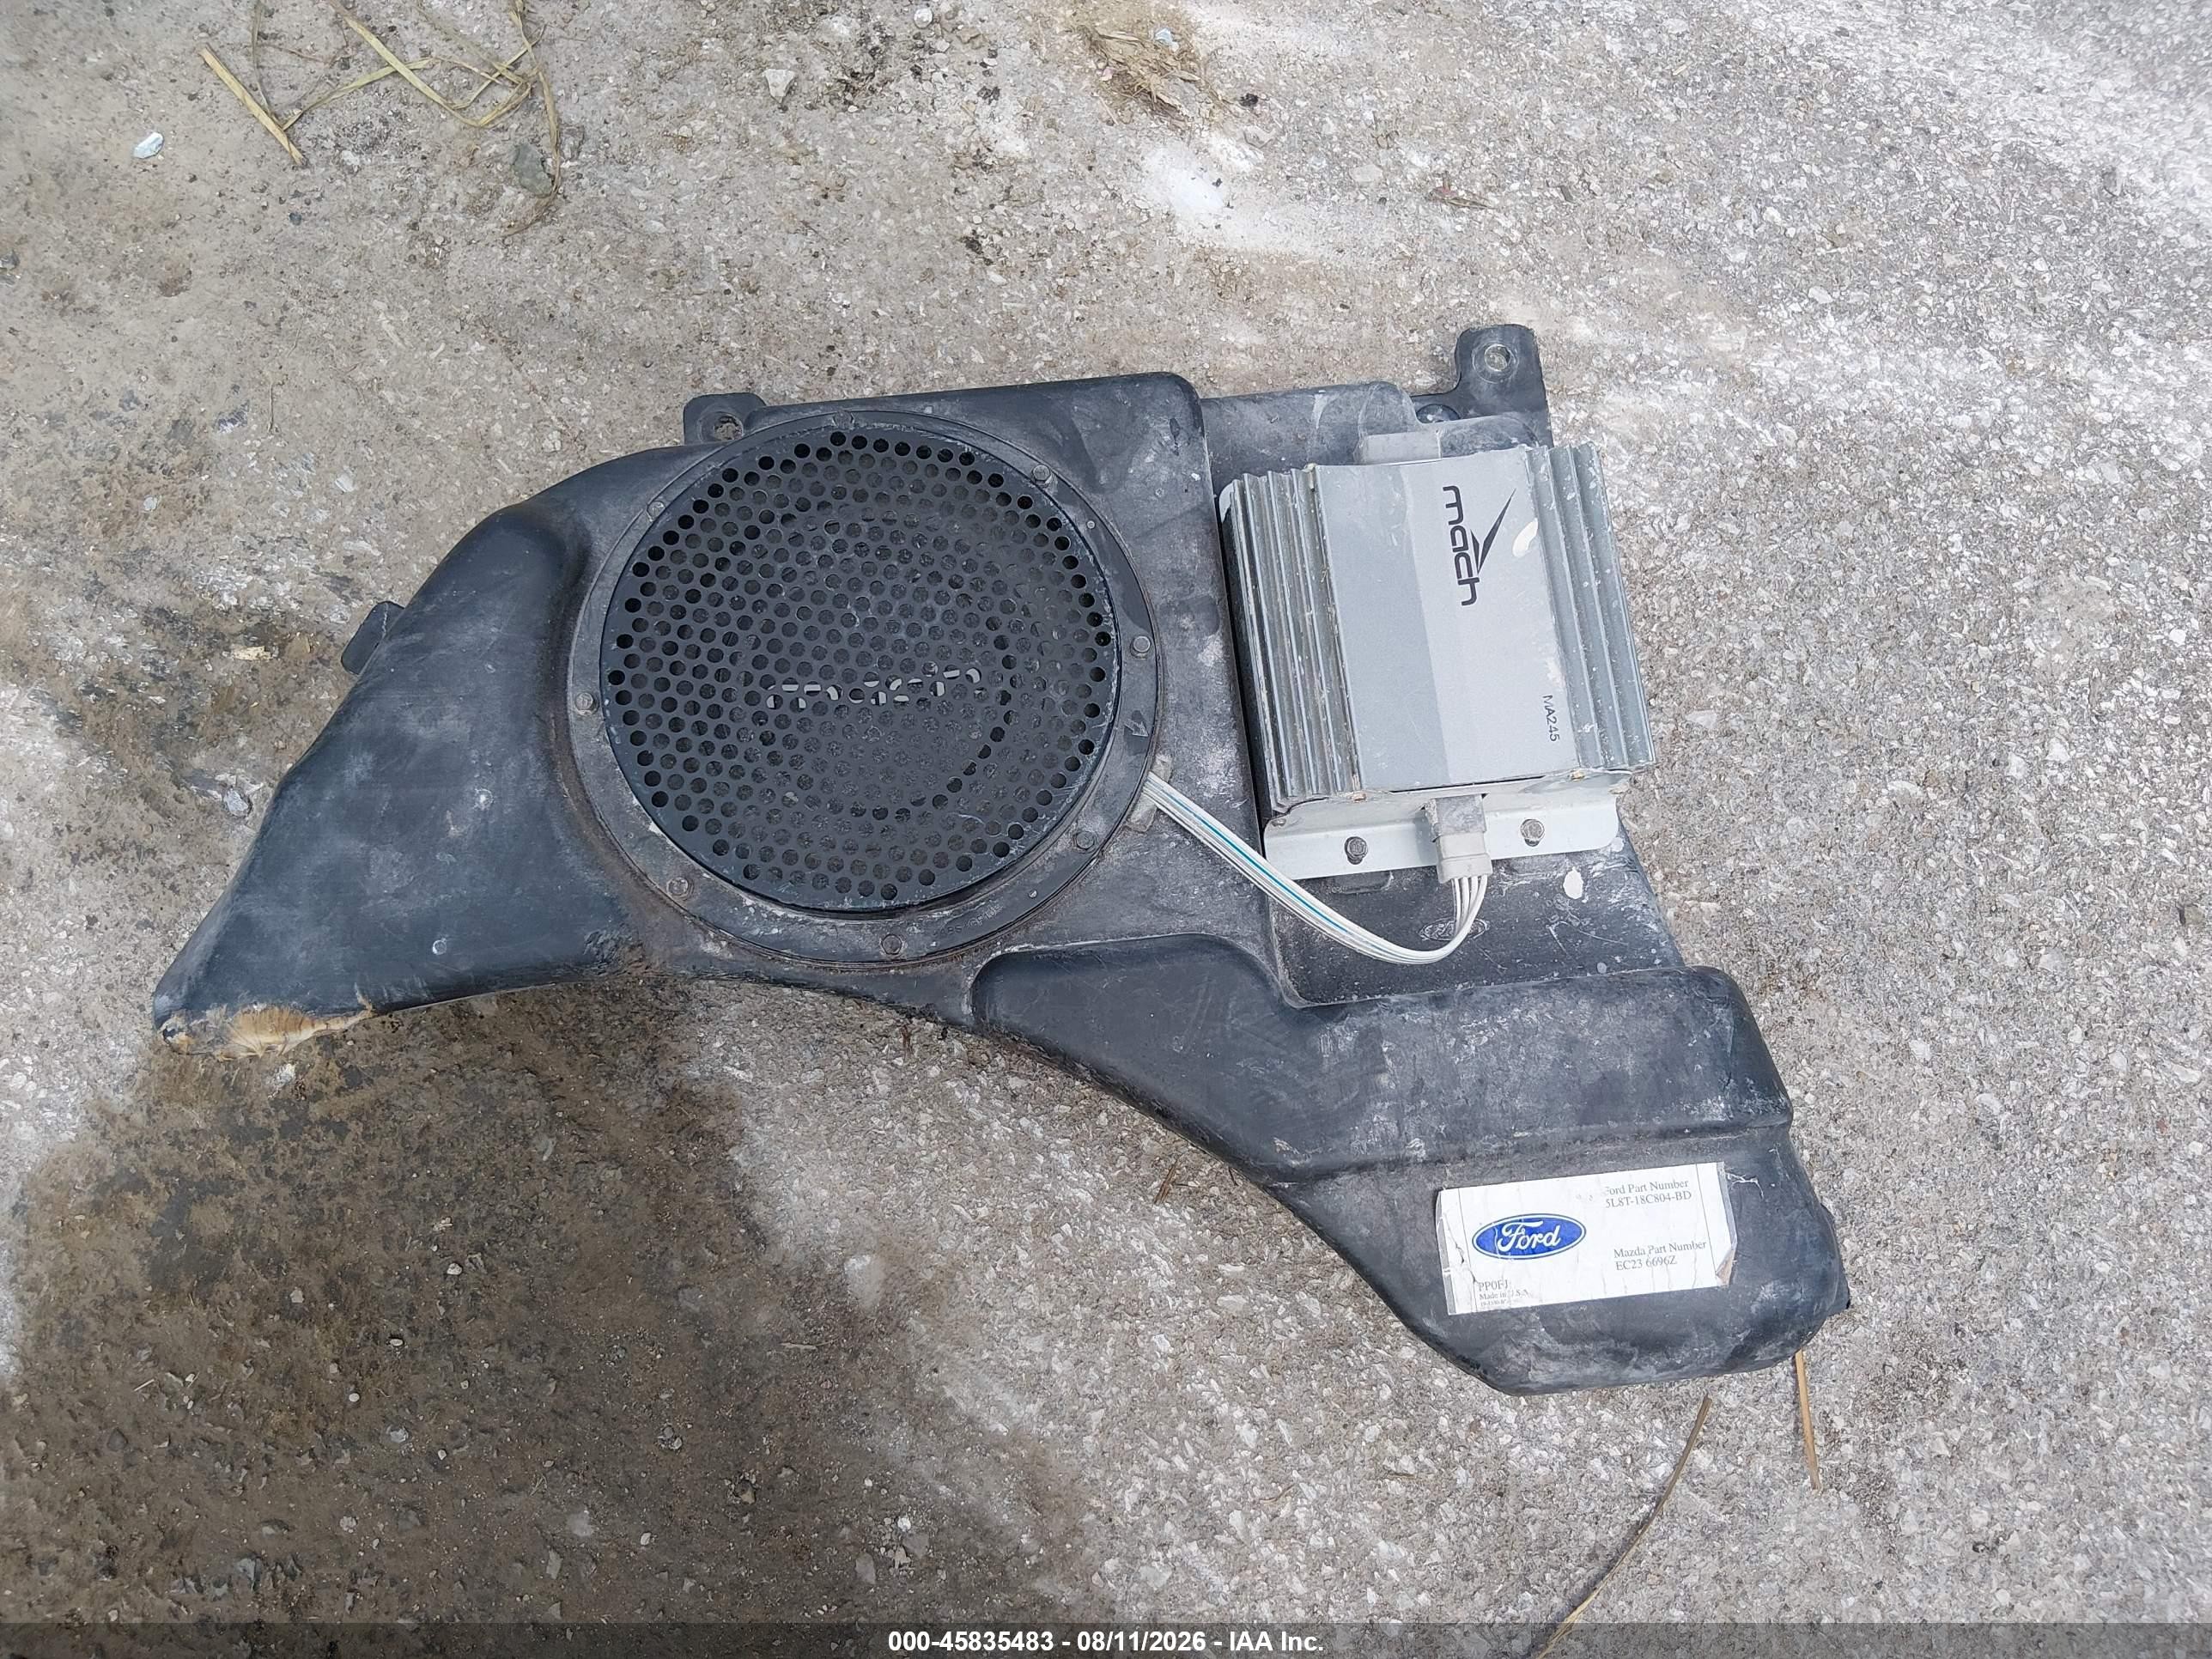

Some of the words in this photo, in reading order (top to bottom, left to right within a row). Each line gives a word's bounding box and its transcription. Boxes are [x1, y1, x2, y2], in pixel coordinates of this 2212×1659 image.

[1442, 485, 1480, 606] mach
[1542, 694, 1560, 743] MA245
[1628, 1183, 1647, 1194] Part
[1650, 1180, 1689, 1192] Number
[1606, 1190, 1692, 1209] 5L8T-18C804-BD
[1497, 1220, 1561, 1252] Ford
[1613, 1246, 1646, 1259] Mazda
[1648, 1243, 1667, 1255] Part
[1669, 1240, 1707, 1253] Number
[1615, 1259, 1643, 1271] EC23
[1645, 1255, 1678, 1268] 6696Z
[1479, 1291, 1498, 1301] Made
